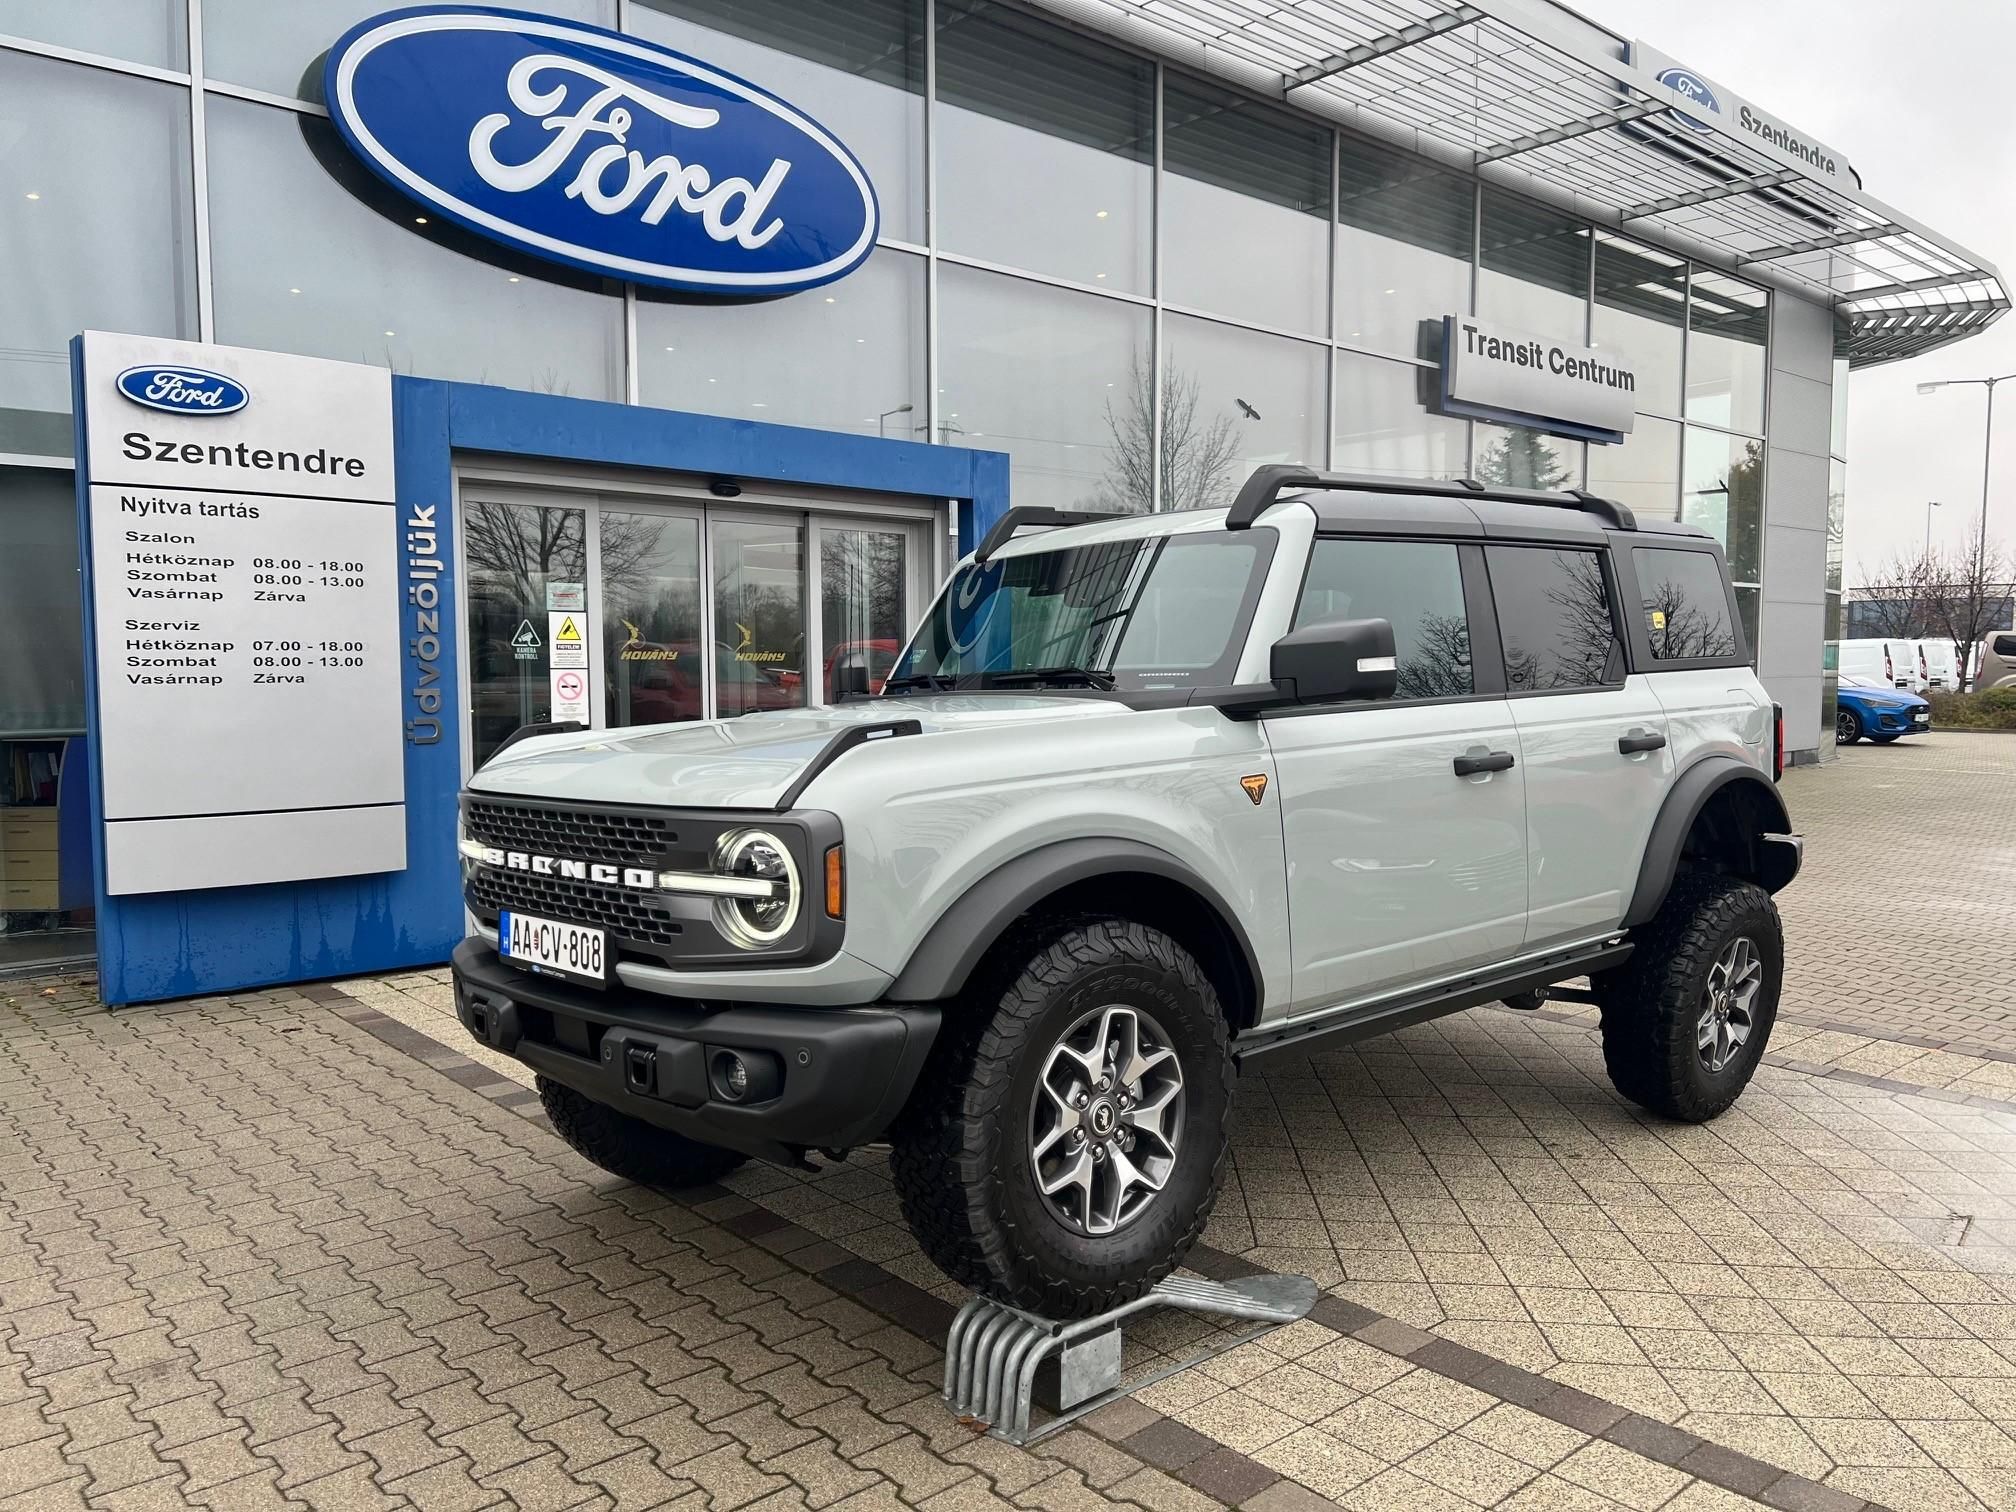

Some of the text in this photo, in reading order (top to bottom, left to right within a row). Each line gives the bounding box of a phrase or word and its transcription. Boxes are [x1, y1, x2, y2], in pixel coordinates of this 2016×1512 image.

[1740, 105, 1836, 177] Szentendre
[468, 53, 792, 250] Ford
[1462, 323, 1636, 392] Transit Centrum
[145, 372, 225, 407] Ford
[122, 432, 366, 478] Szentendre
[120, 495, 261, 519] Nyitva tartás
[125, 530, 196, 545] Szalon
[126, 552, 235, 568] Hétköznap
[252, 557, 302, 570] 08.00
[319, 560, 365, 573] 18.00
[126, 569, 218, 583] Szombat
[253, 573, 303, 586] 08.00
[319, 576, 365, 588] 13.00
[126, 587, 307, 602] Vasárnap Zárva
[125, 619, 201, 632] Szerviz
[406, 503, 444, 746] Üdvözöljük
[126, 639, 235, 653] Hétköznap
[252, 640, 302, 652] 07.00
[318, 641, 364, 652] 18.00
[620, 649, 679, 661] HOVÁNY
[126, 656, 218, 668] Szombat
[252, 656, 302, 668] 08.00
[319, 656, 365, 668] 13.00
[735, 651, 786, 662] HOVÁNY
[126, 672, 306, 687] Vasárnap Zárva
[484, 847, 654, 889] BRONCO
